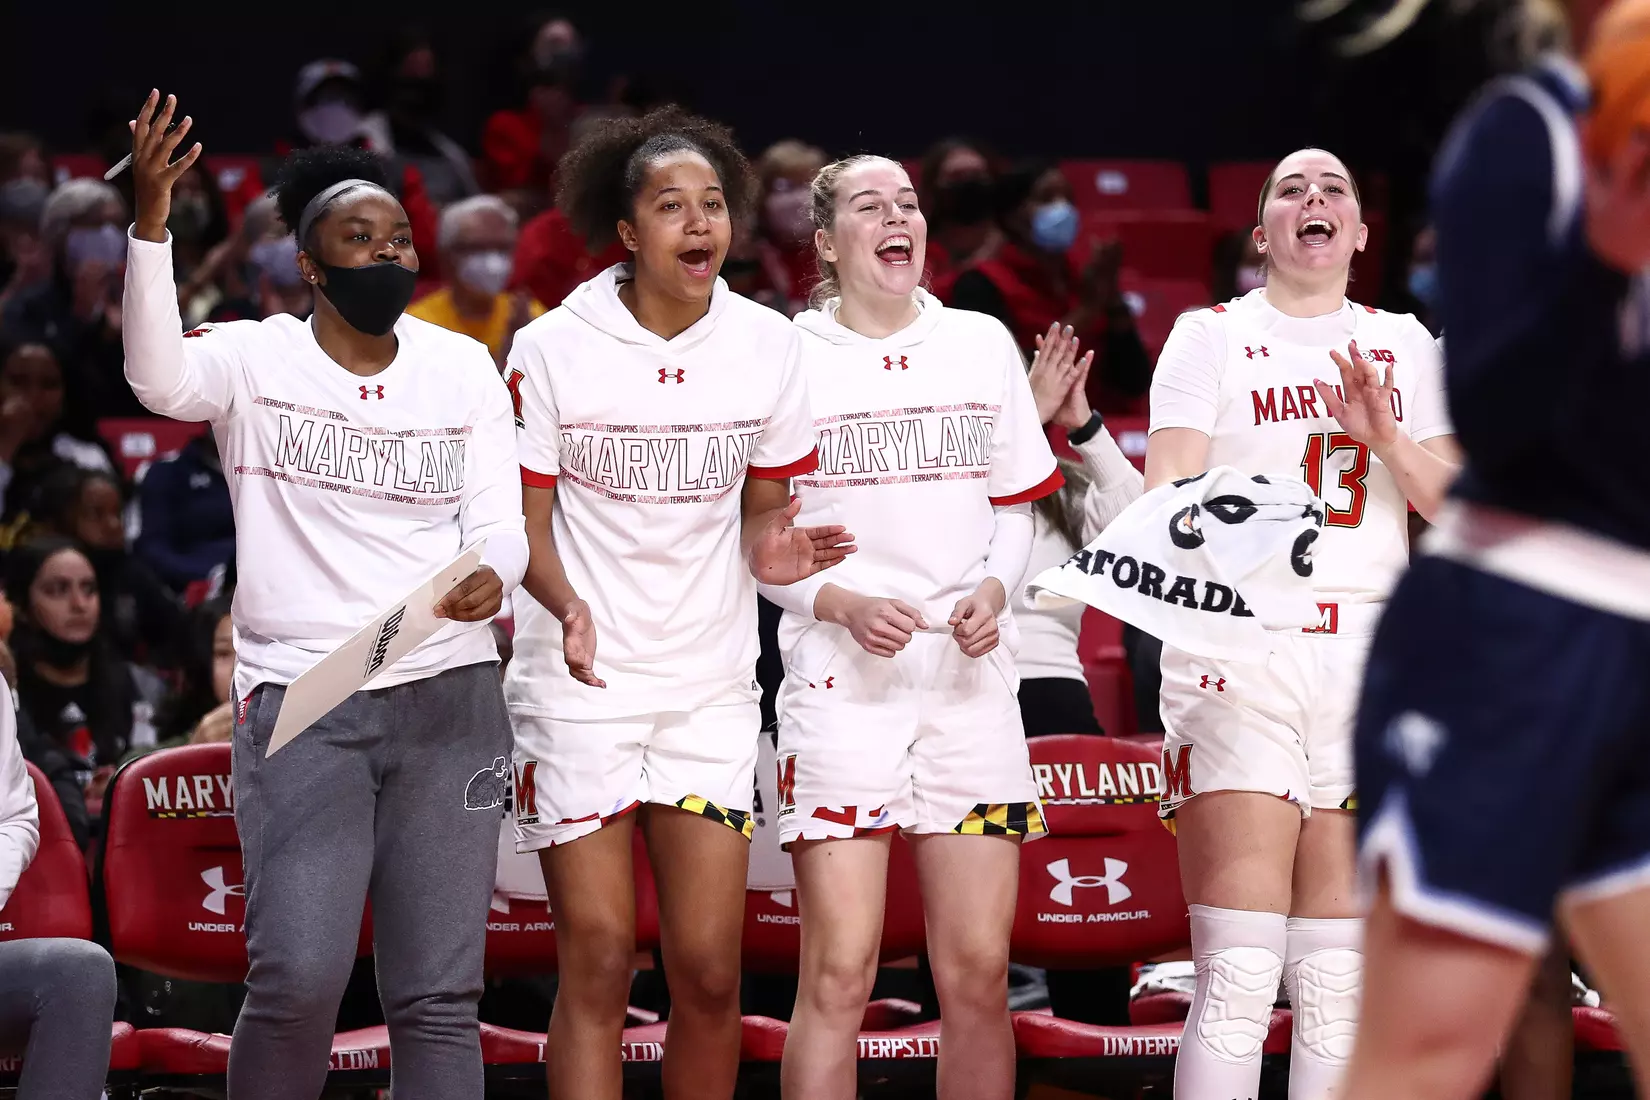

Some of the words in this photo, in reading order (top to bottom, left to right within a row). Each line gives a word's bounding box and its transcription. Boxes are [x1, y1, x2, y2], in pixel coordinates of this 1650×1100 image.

[263, 397, 296, 412] TERRAPINS
[1251, 384, 1404, 427] MARD
[840, 411, 872, 422] TERRAPINS
[904, 405, 935, 416] TERRAPINS
[606, 424, 639, 434] TERRAPINS
[671, 423, 703, 434] TERRAPINS
[846, 476, 880, 488] TERRAPINS
[911, 472, 943, 483] TERRAPINS
[1300, 431, 1371, 530] 13
[318, 480, 352, 495] TERRAPINS
[384, 492, 417, 505] TERRAPINS
[605, 488, 637, 503] TERRAPINS
[670, 494, 702, 505] TERRAPINS
[368, 604, 407, 677] Wilson
[1161, 744, 1197, 803] M
[757, 913, 801, 925] UNDER
[1037, 912, 1084, 923] UNDER
[188, 920, 235, 933] UNDER
